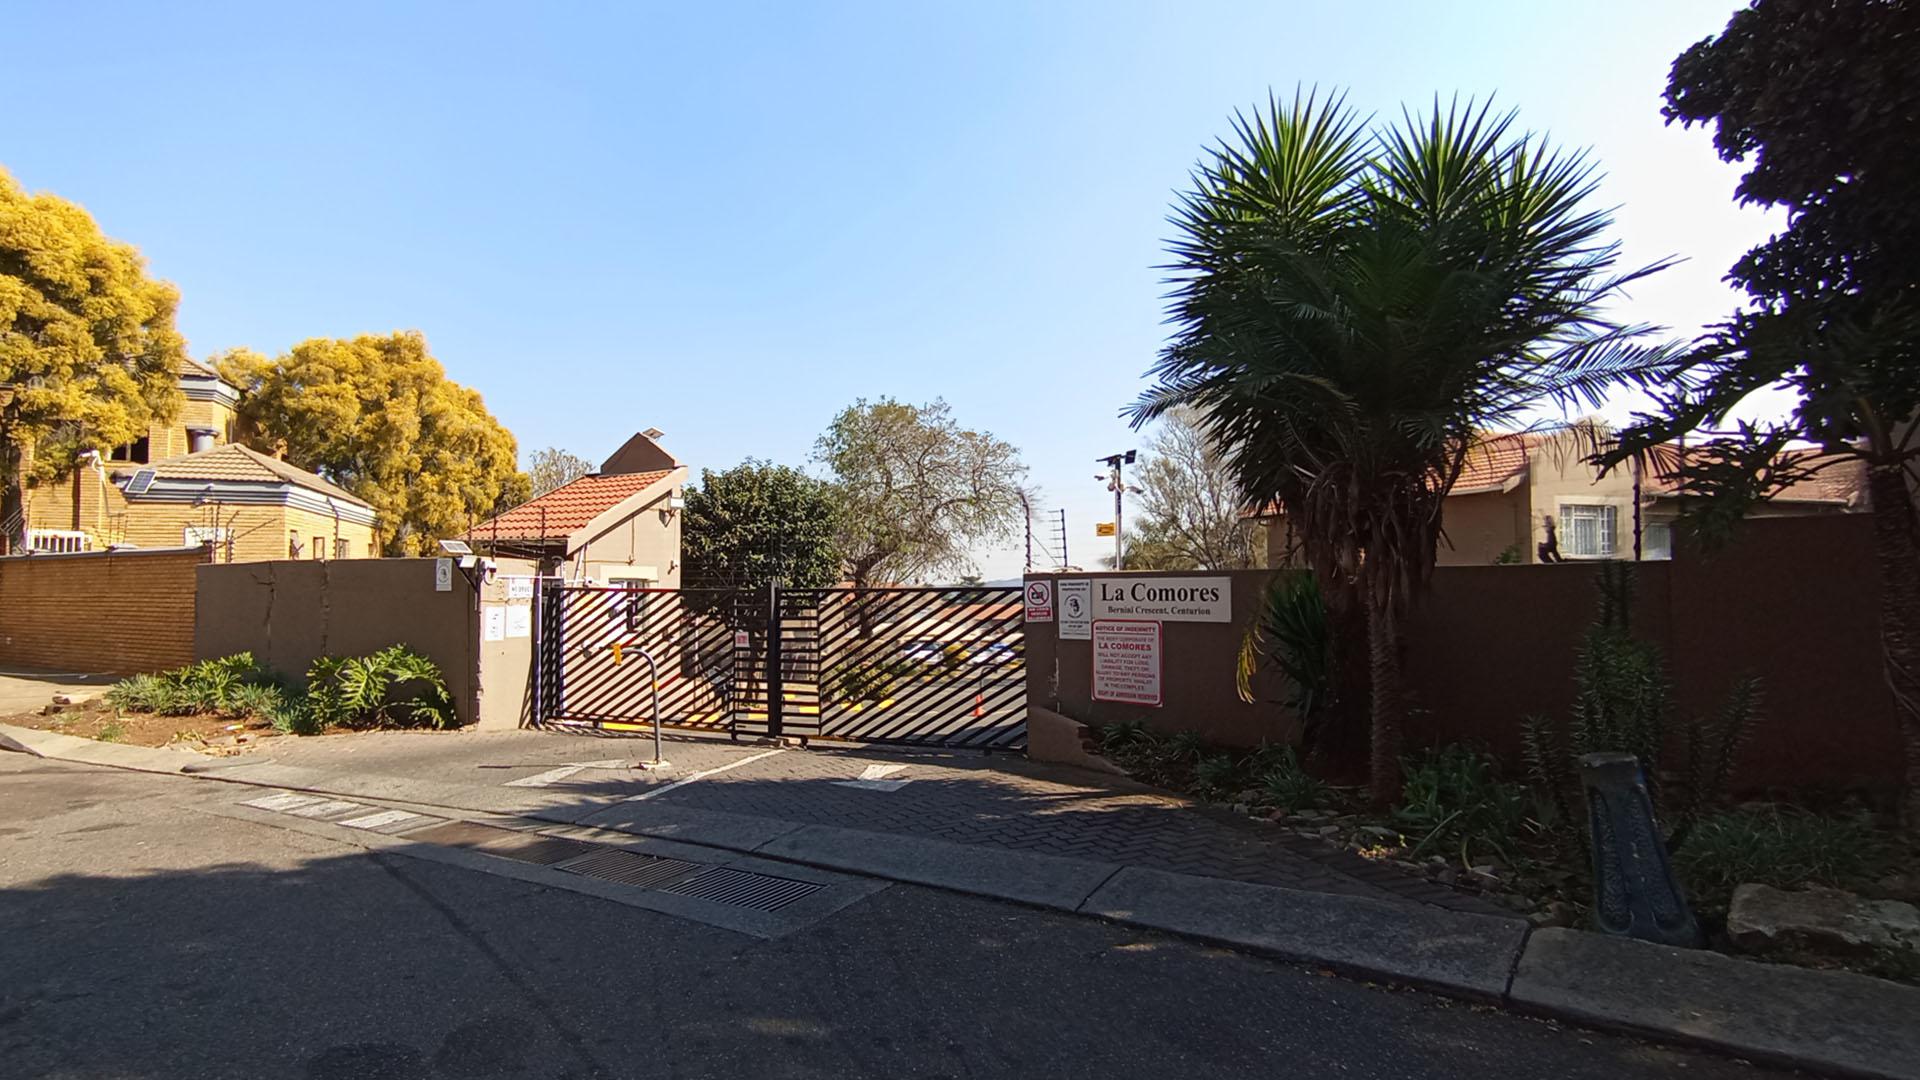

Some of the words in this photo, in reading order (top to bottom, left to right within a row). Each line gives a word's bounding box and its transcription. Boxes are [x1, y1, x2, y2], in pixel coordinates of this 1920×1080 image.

[1101, 584, 1124, 601] La
[1131, 582, 1220, 602] Comores
[1108, 606, 1133, 614] Bernini
[1136, 606, 1168, 616] Crescent,
[1170, 607, 1210, 616] Centurion
